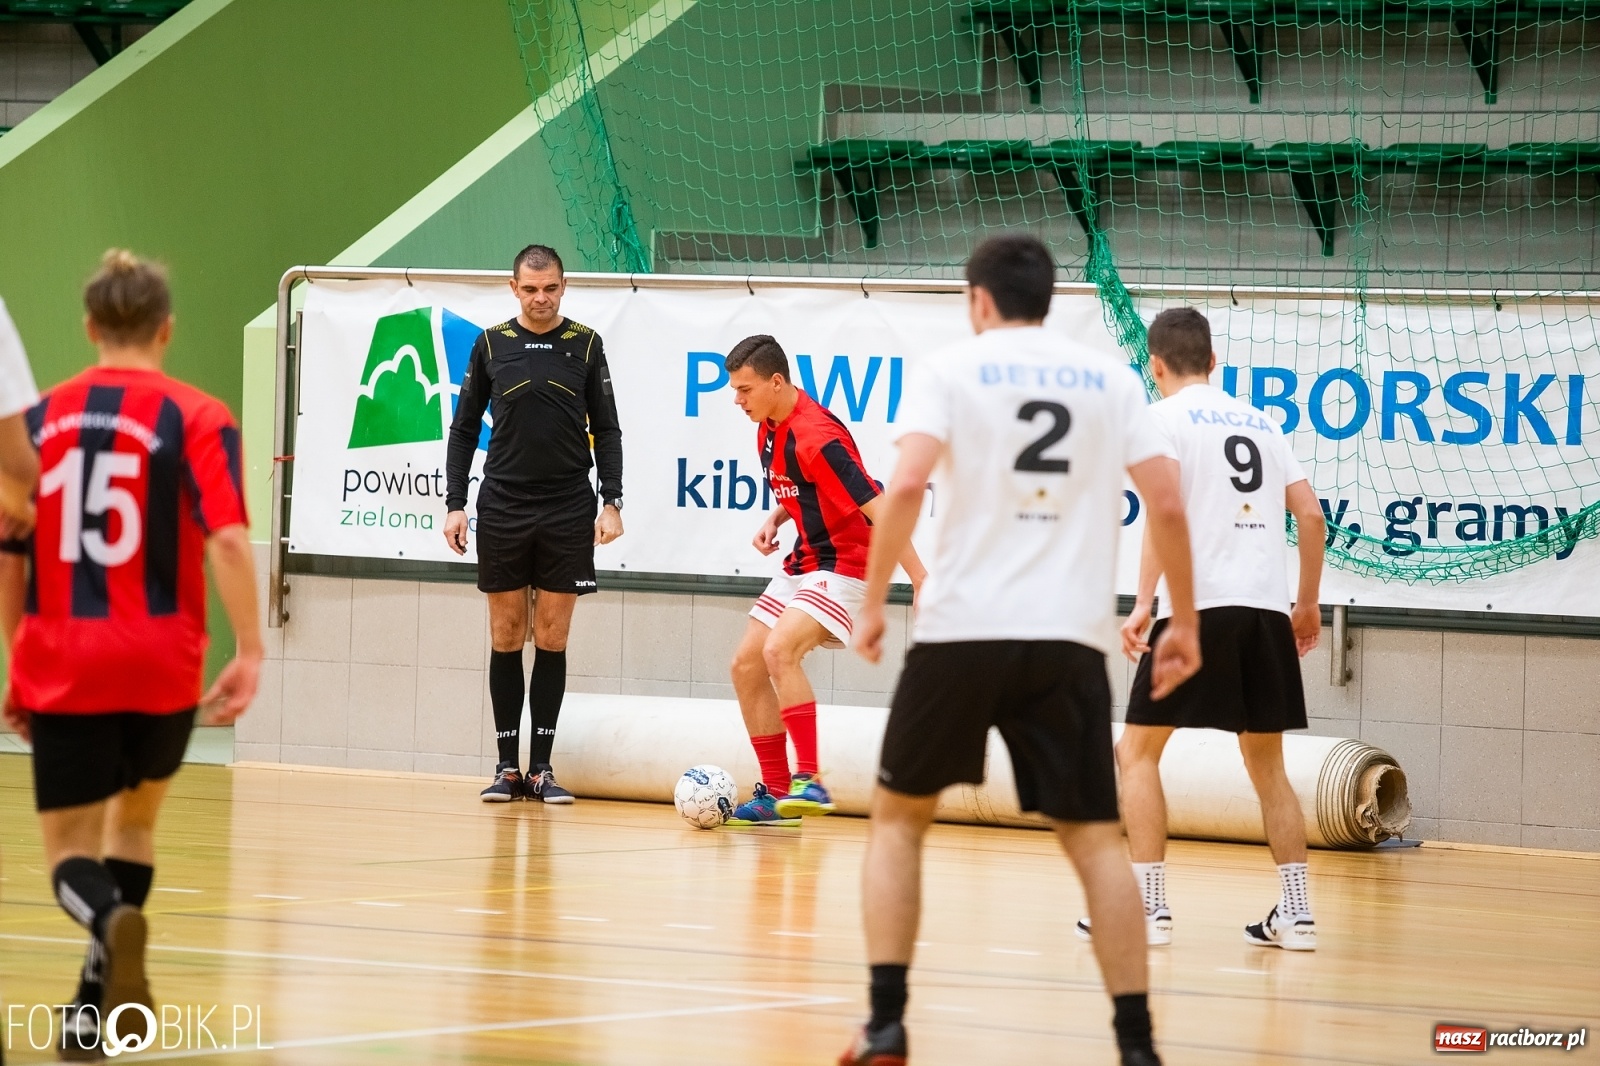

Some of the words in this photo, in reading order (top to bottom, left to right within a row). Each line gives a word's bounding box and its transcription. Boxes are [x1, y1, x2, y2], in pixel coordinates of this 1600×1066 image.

[685, 351, 903, 424] PWI
[978, 363, 1108, 393] BETON
[1014, 401, 1072, 473] 2
[1188, 408, 1274, 434] KACZA
[342, 462, 444, 502] powiat
[1224, 435, 1263, 493] 9
[39, 446, 143, 567] 15
[774, 483, 800, 499] cha
[340, 504, 434, 530] zielona
[1381, 496, 1587, 561] gramy
[536, 727, 556, 736] zin
